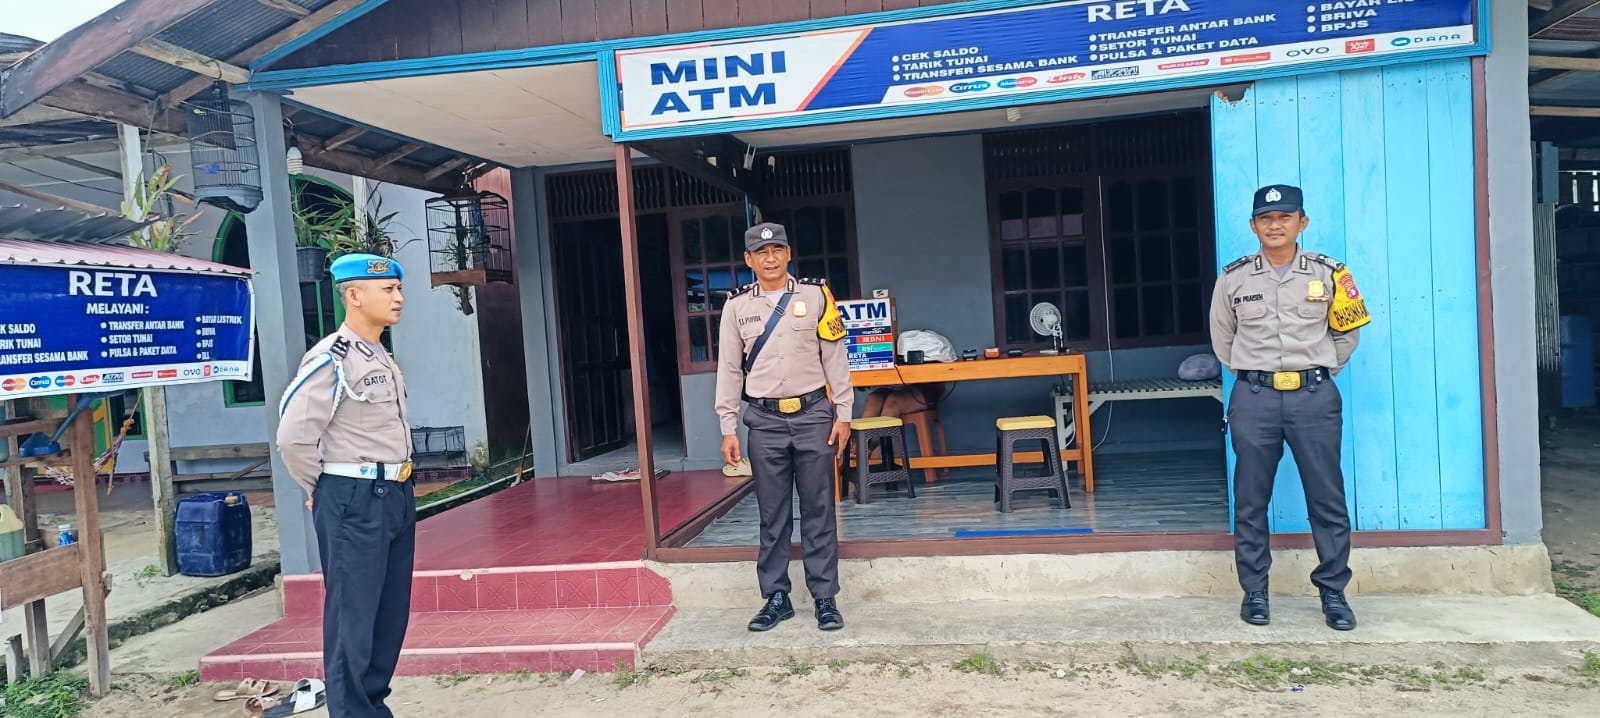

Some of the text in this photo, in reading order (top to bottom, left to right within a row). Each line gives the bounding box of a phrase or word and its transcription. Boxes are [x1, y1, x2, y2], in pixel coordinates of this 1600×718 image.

[1087, 0, 1190, 23] RETA
[1320, 0, 1380, 12] BAYAR
[1321, 8, 1378, 21] BRIVA
[1098, 13, 1277, 41] TRANSFER ANTAR BANK
[1321, 20, 1369, 32] BPJS
[1099, 33, 1197, 51] SETOR TUNAI
[1413, 33, 1461, 43] DANA
[902, 47, 979, 62] CEK SALDO
[1100, 36, 1259, 62] PULSA & PAKET DATA
[1286, 46, 1330, 57] OVO
[650, 50, 787, 85] MINI
[902, 56, 989, 71] TARIK TUNAI
[902, 55, 1078, 81] TRANSFER SESAMA BANK
[1048, 72, 1083, 83] Link
[951, 81, 989, 91] Cirrus
[650, 82, 777, 116] ATM
[69, 270, 158, 297] RETA
[837, 302, 887, 320] ATM
[108, 320, 185, 330] TRANSFER ANTAR BANK
[217, 315, 243, 325] LISTRIK
[8, 323, 36, 334] SALDO
[15, 337, 42, 349] TUNAI
[108, 333, 153, 344] SETOR TUNAI
[34, 351, 66, 363] SESAMA
[67, 350, 89, 361] BANK
[109, 347, 132, 358] PULSA
[139, 346, 160, 356] PAKET
[160, 345, 177, 355] DATA
[183, 368, 201, 376] OVO
[363, 375, 387, 386] GATOT
